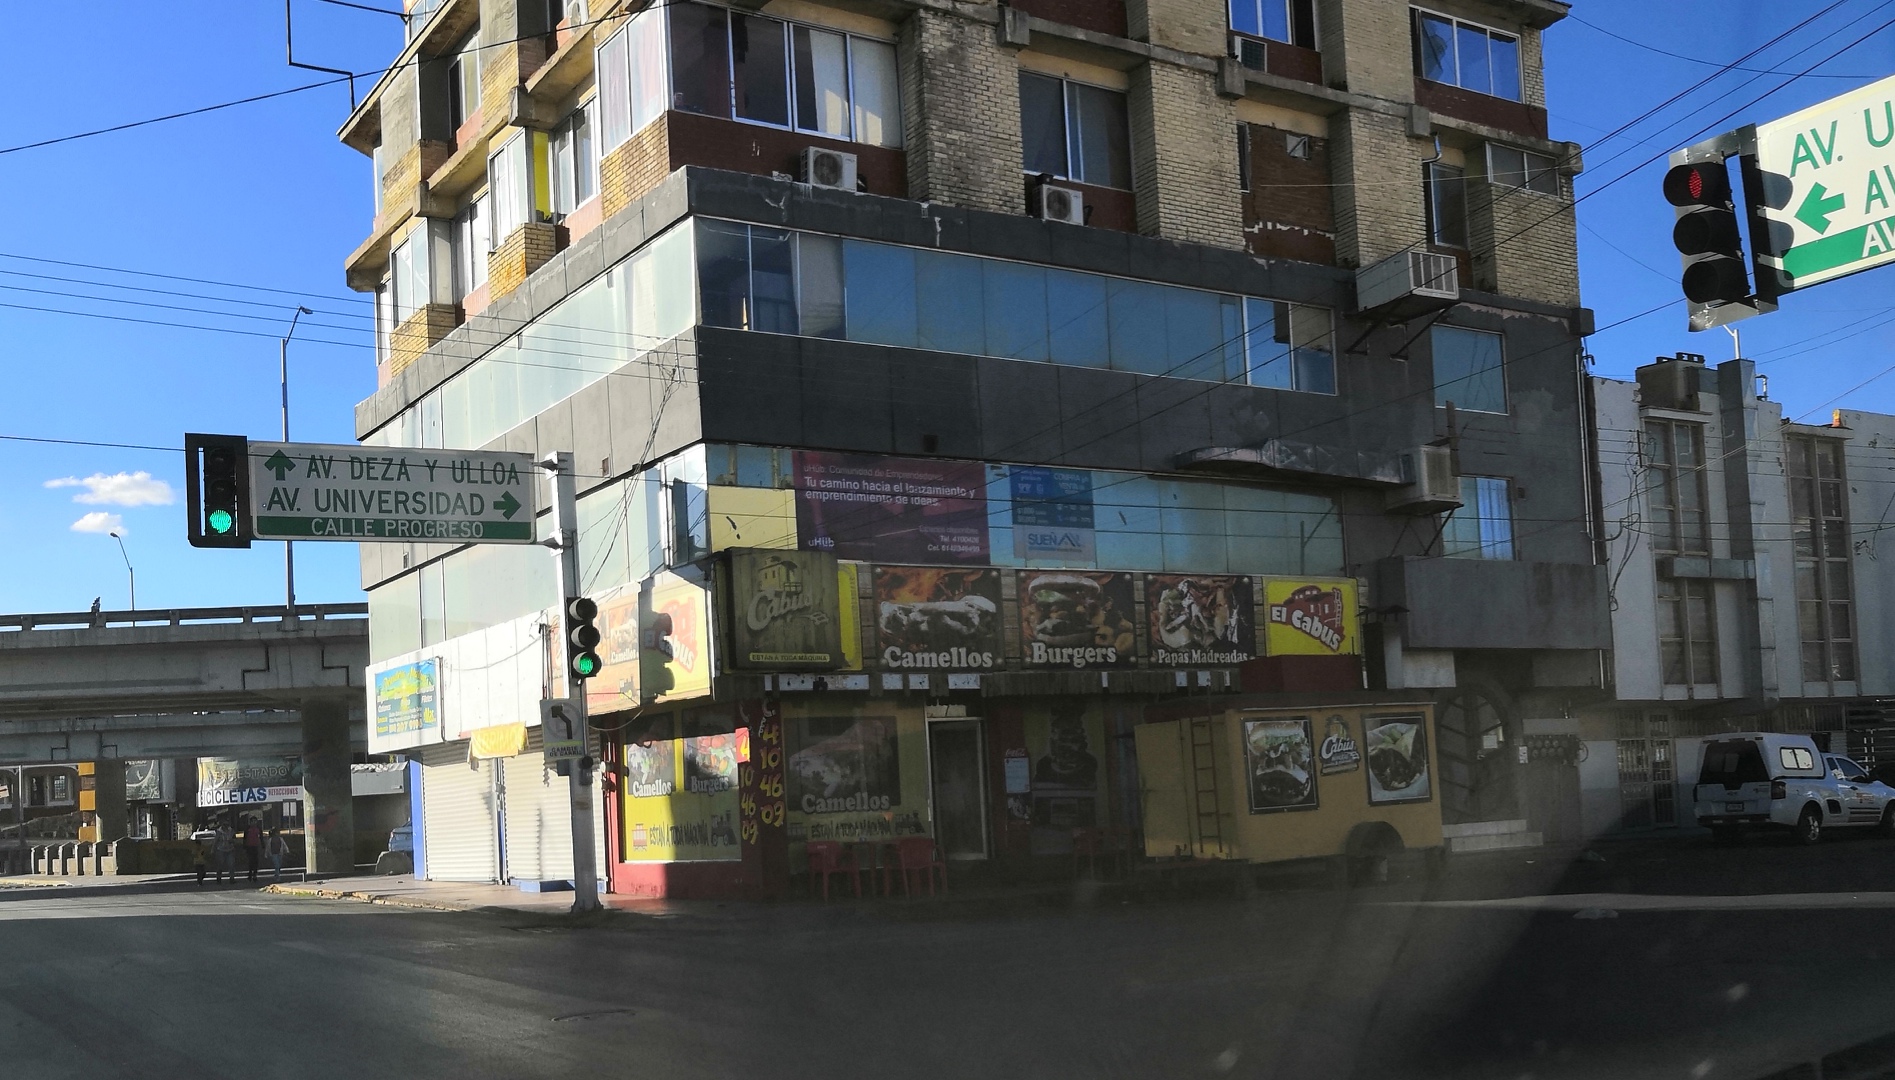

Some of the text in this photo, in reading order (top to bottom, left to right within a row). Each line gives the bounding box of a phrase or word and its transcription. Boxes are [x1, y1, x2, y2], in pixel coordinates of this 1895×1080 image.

[1790, 120, 1844, 178] AV.
[307, 455, 520, 485] AV. DEZA Y ULLOA
[804, 476, 976, 499] Tu camino hacia el lanzamiento y
[806, 490, 893, 504] emprendimiento
[896, 493, 909, 505] de
[266, 487, 485, 516] AV. UNIVERSIDAD
[311, 519, 484, 538] CALLE PROGRESO
[1291, 609, 1341, 651] Cabus
[884, 645, 993, 668] Camellos
[1031, 642, 1117, 667] Burgers
[1158, 649, 1249, 666] Papas Madreadas
[760, 747, 781, 770] 10
[633, 775, 729, 797] Camellos Burgers
[760, 773, 783, 797] 46
[802, 791, 890, 814] Camellos
